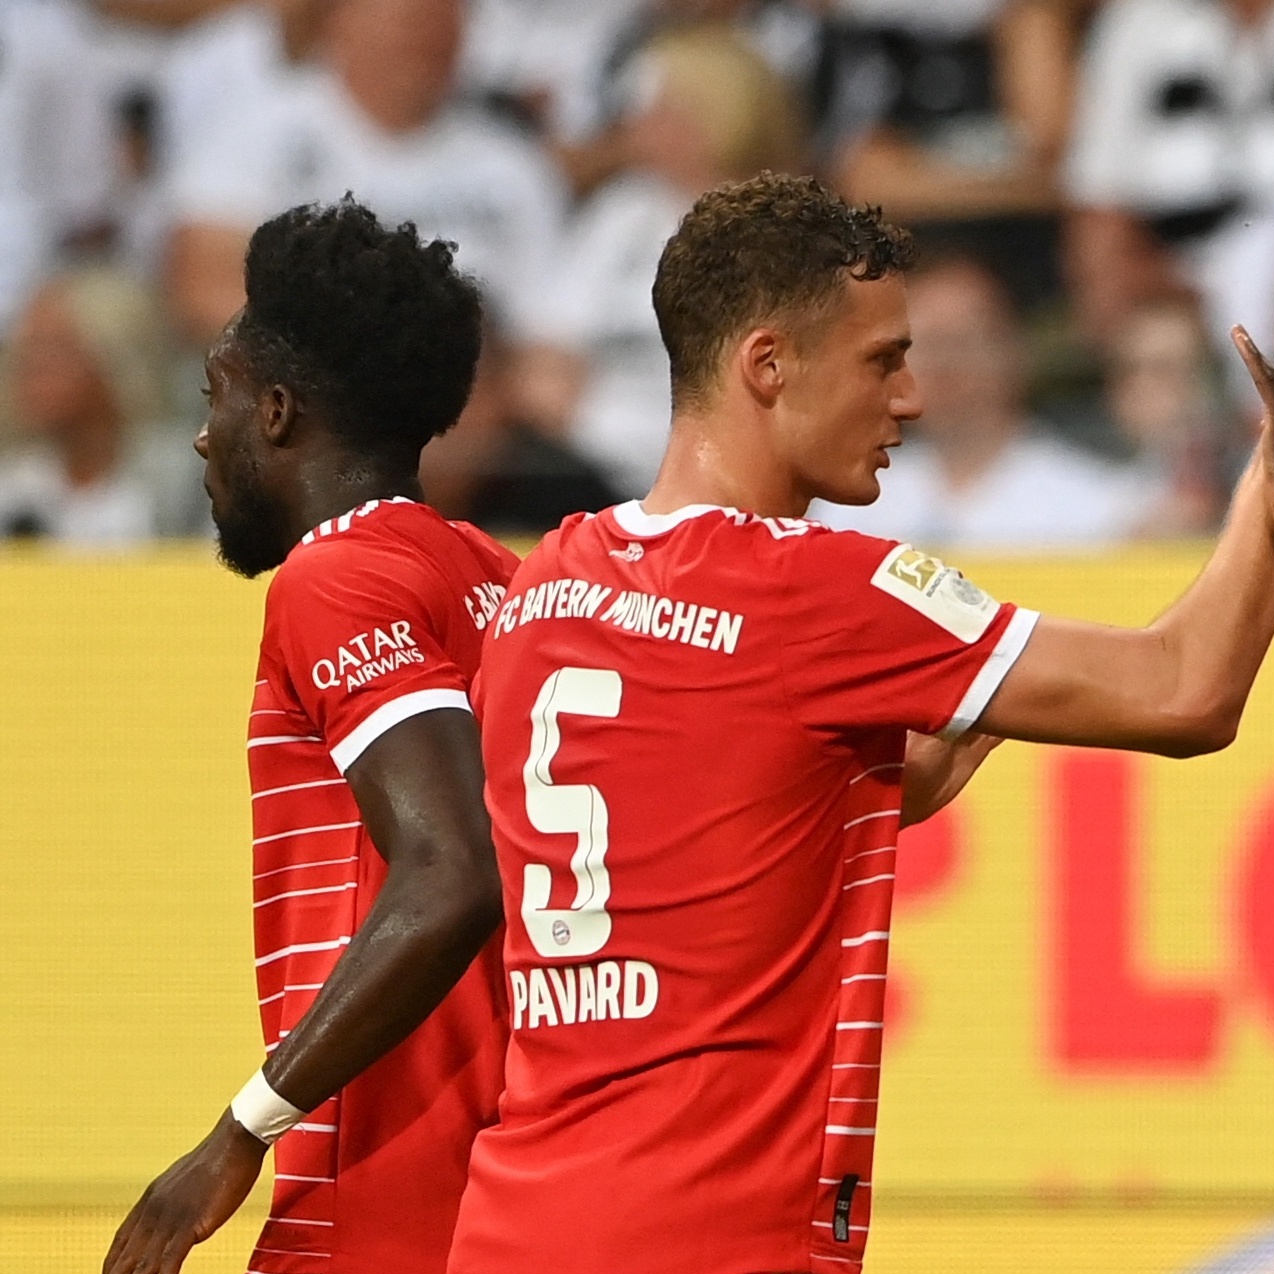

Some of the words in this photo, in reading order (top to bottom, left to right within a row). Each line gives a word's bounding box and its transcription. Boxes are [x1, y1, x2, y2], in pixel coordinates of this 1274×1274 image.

[494, 595, 521, 640] FC
[519, 578, 613, 627] BAYERN
[599, 590, 744, 655] MÜNCHEN
[312, 620, 417, 690] QATAR
[346, 647, 425, 693] AIRWAYS
[521, 666, 622, 957] 5
[509, 960, 659, 1030] PAVARD
